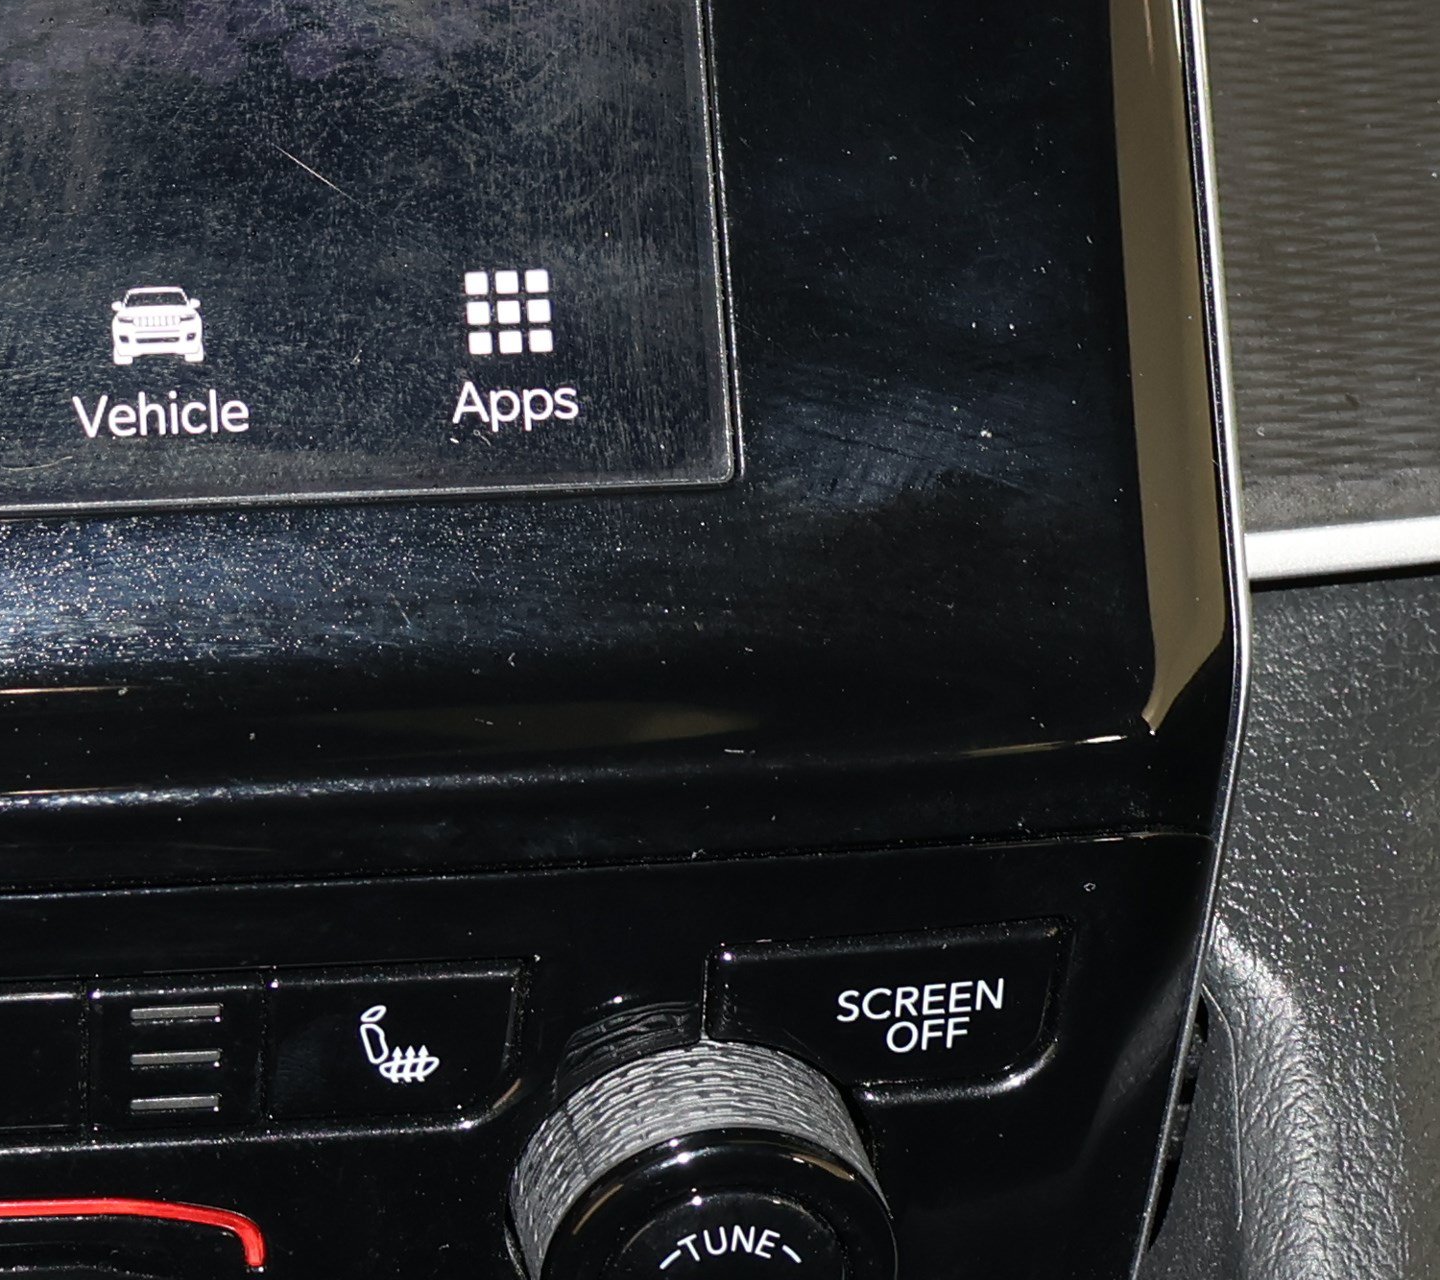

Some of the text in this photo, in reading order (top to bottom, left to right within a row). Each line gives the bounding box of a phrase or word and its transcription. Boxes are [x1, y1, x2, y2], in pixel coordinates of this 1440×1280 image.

[72, 388, 249, 438] Vehicle
[452, 380, 579, 433] Apps
[836, 977, 1004, 1025] SCREEN
[886, 1010, 971, 1055] OFF
